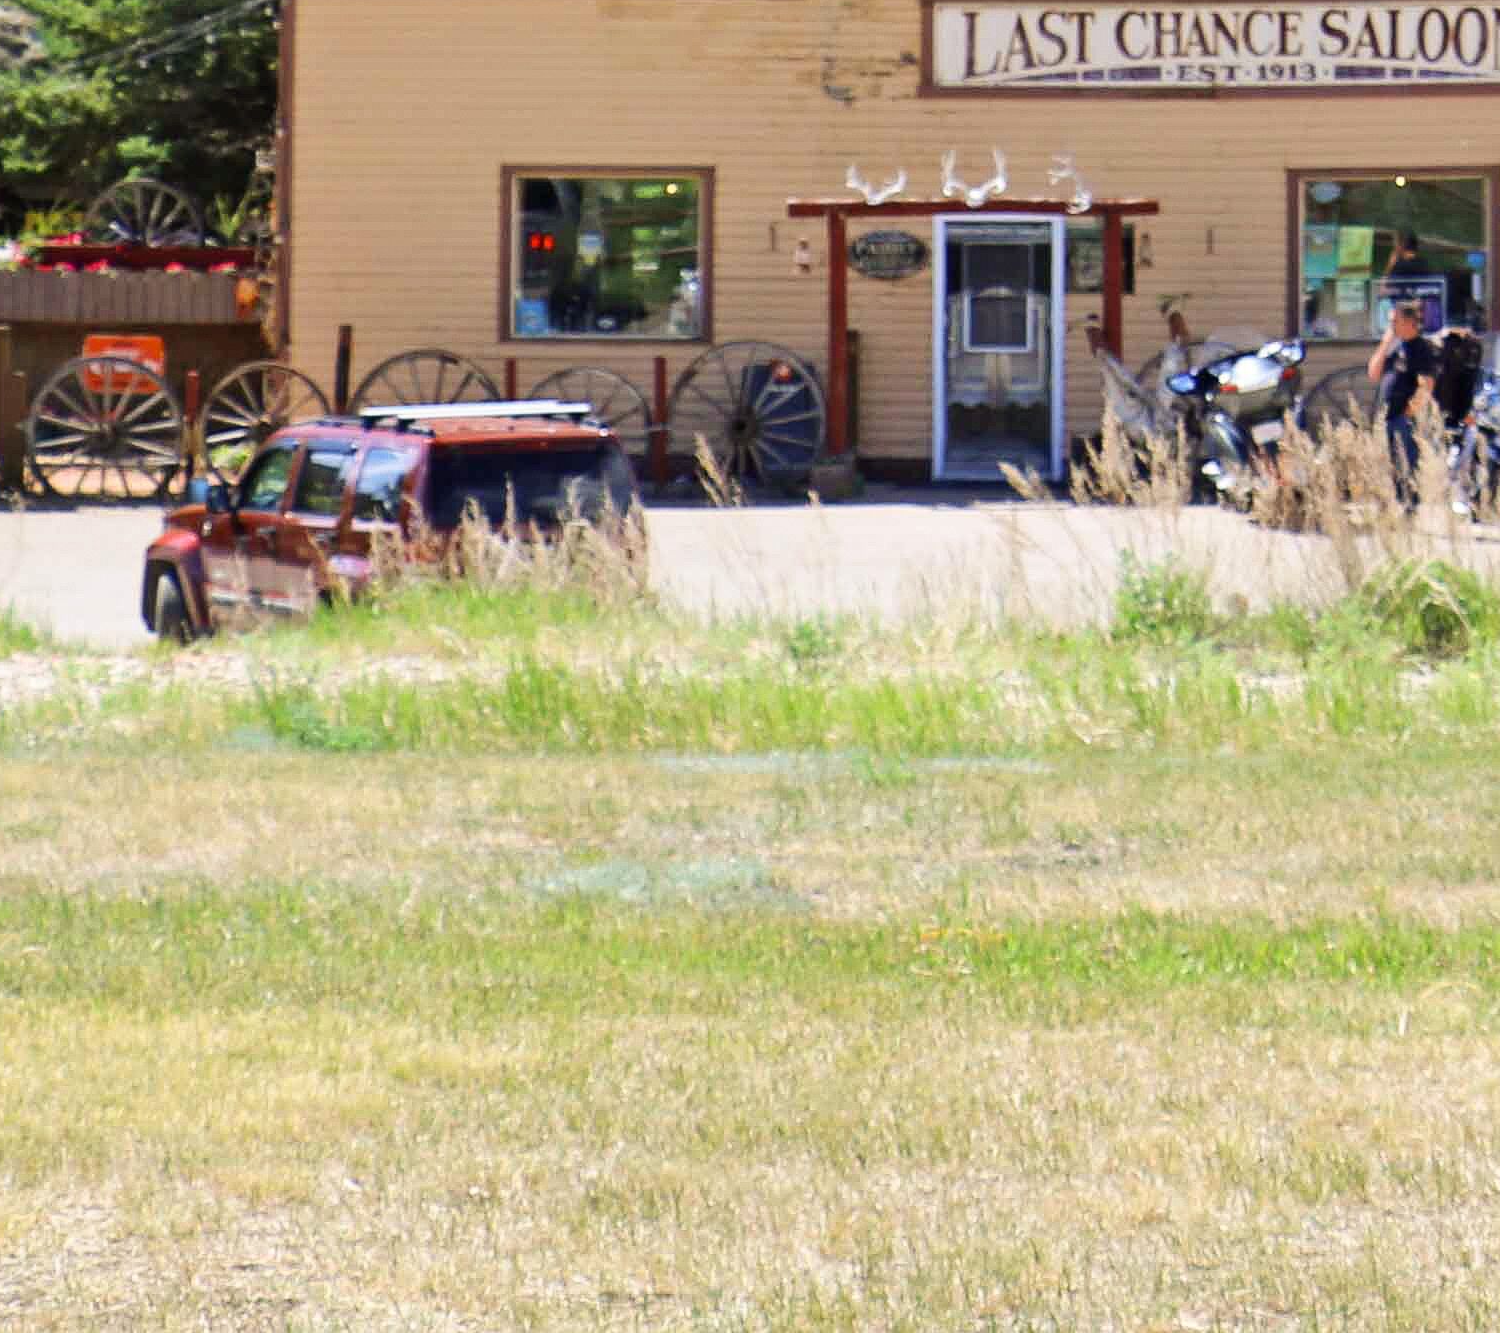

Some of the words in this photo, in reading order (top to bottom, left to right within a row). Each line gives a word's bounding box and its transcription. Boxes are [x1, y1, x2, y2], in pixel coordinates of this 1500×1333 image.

[963, 11, 1096, 78] LAST
[1114, 9, 1304, 60] CHANCE
[1257, 63, 1317, 82] 1913
